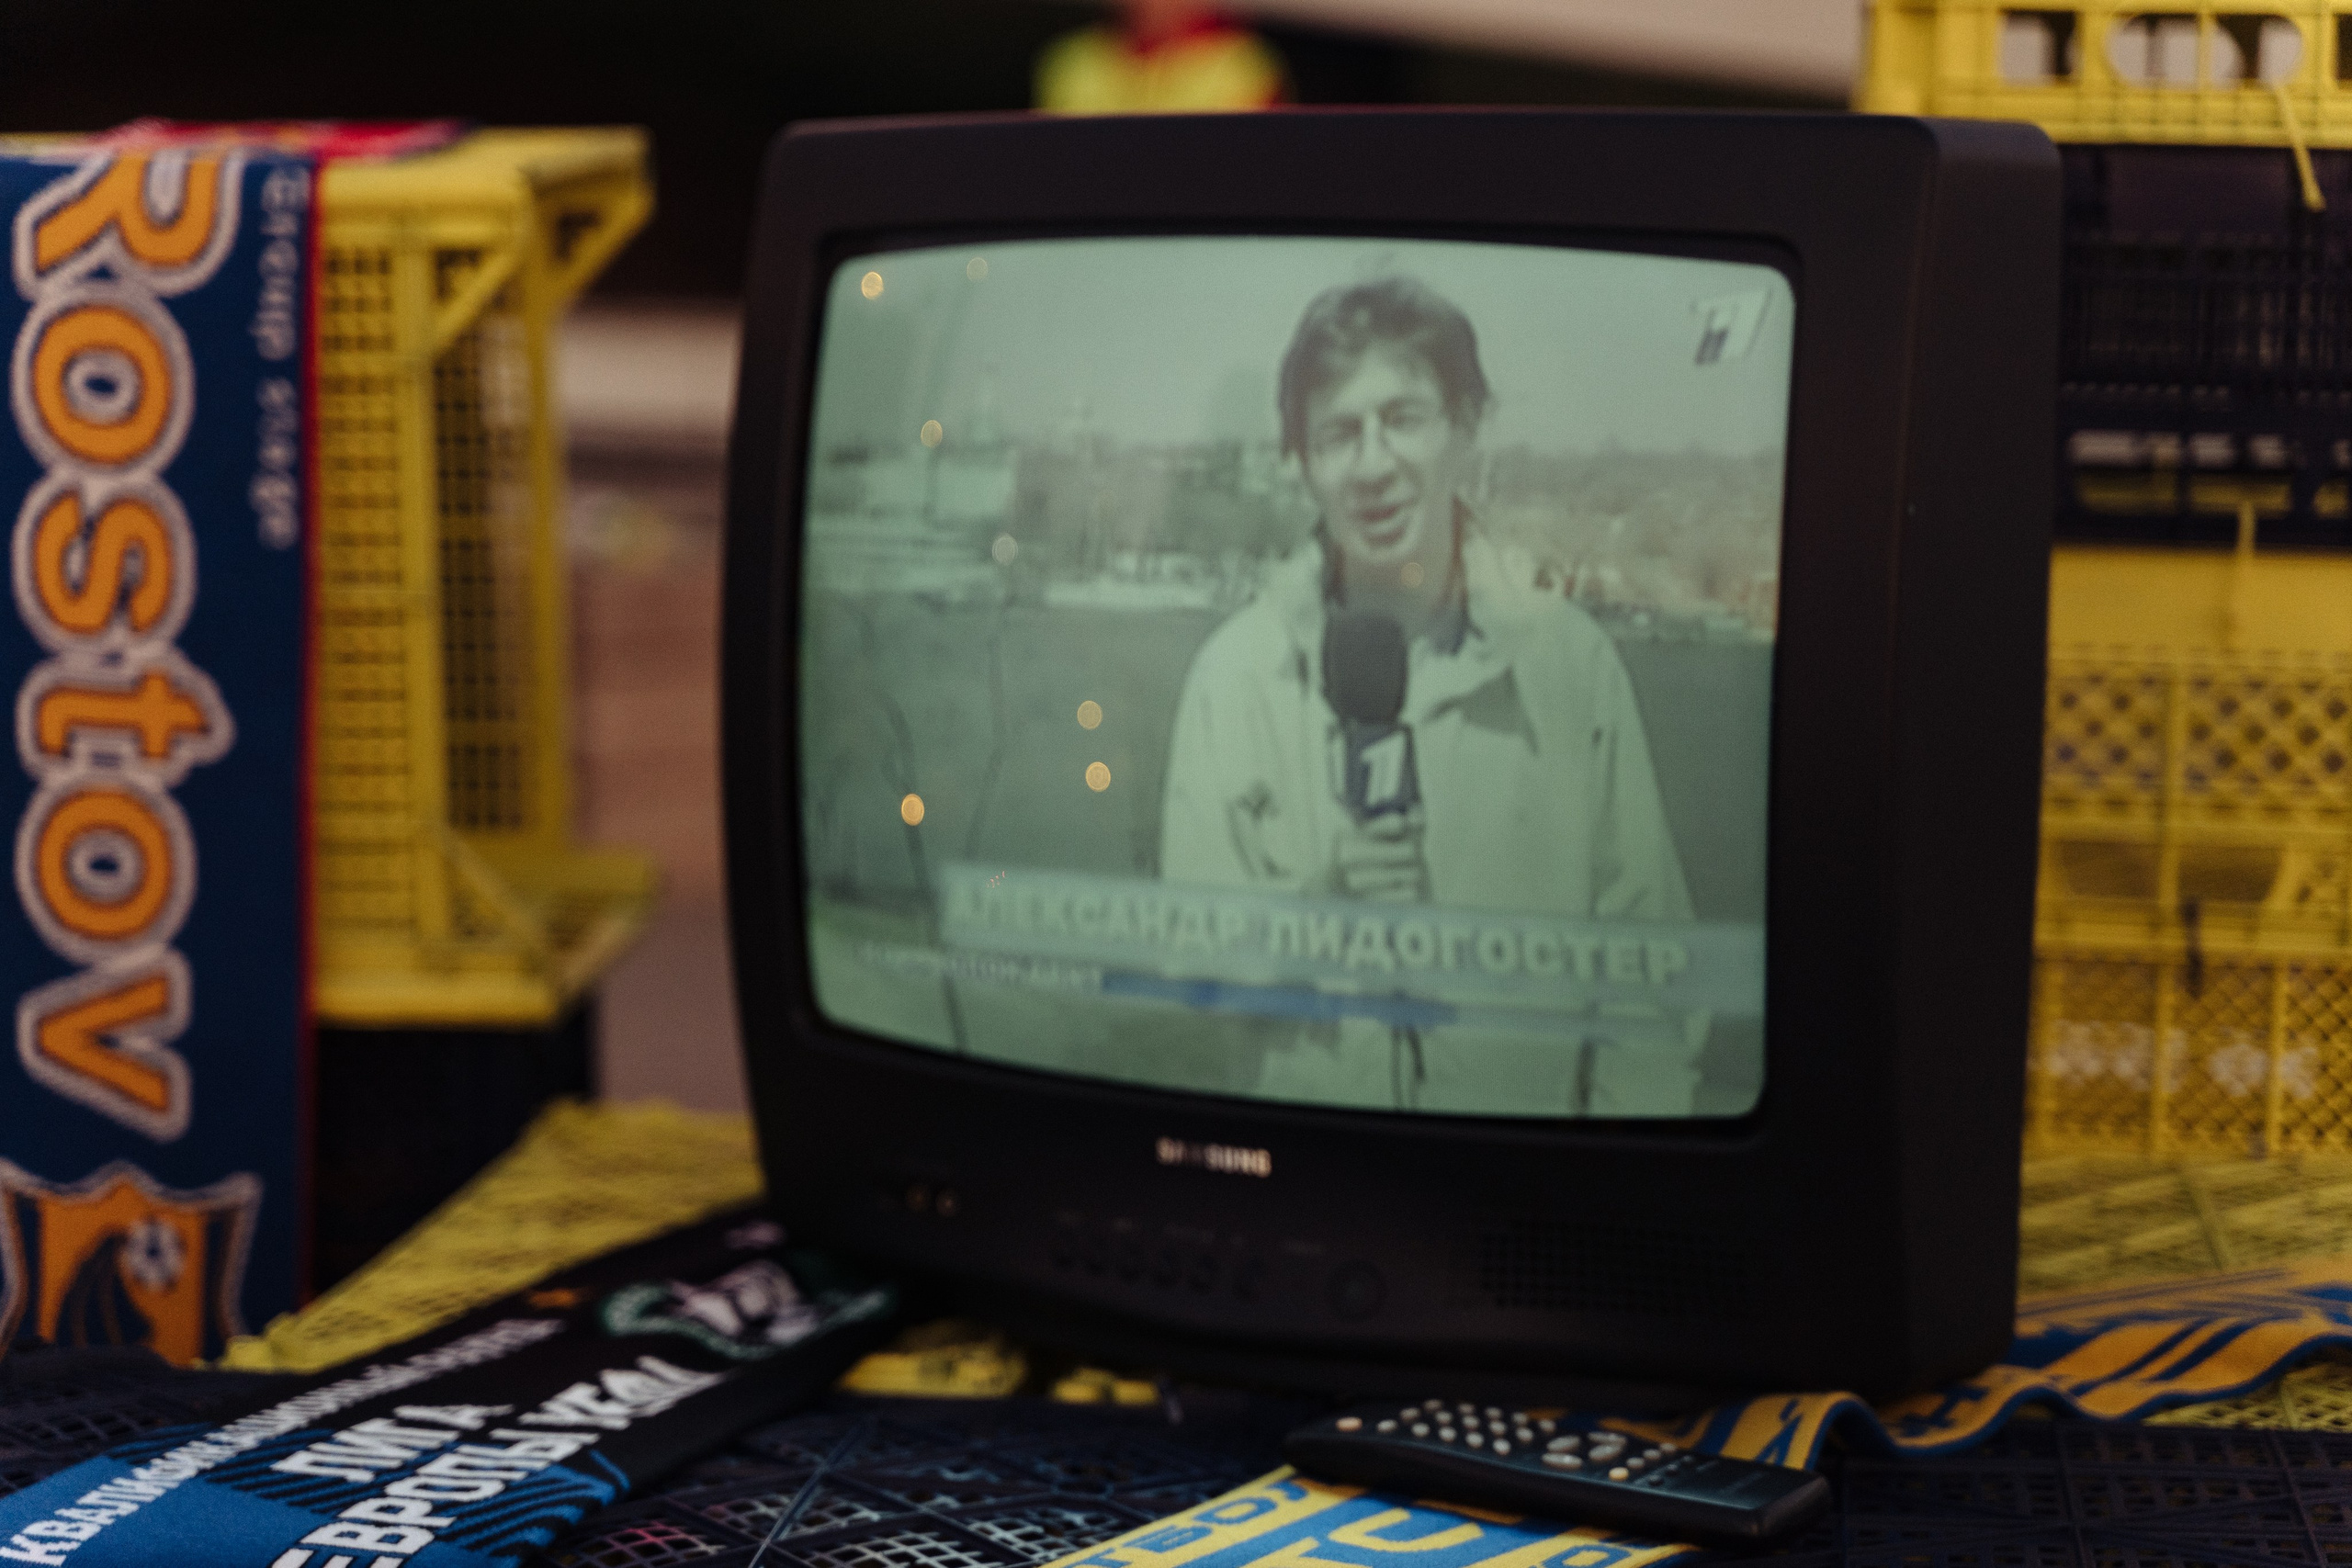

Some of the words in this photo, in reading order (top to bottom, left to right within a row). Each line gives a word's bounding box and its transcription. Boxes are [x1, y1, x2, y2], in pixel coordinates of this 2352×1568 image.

[13, 147, 244, 1137] Rostov
[1155, 1136, 1272, 1178] SASUNG
[270, 1403, 514, 1483] ЛИГА
